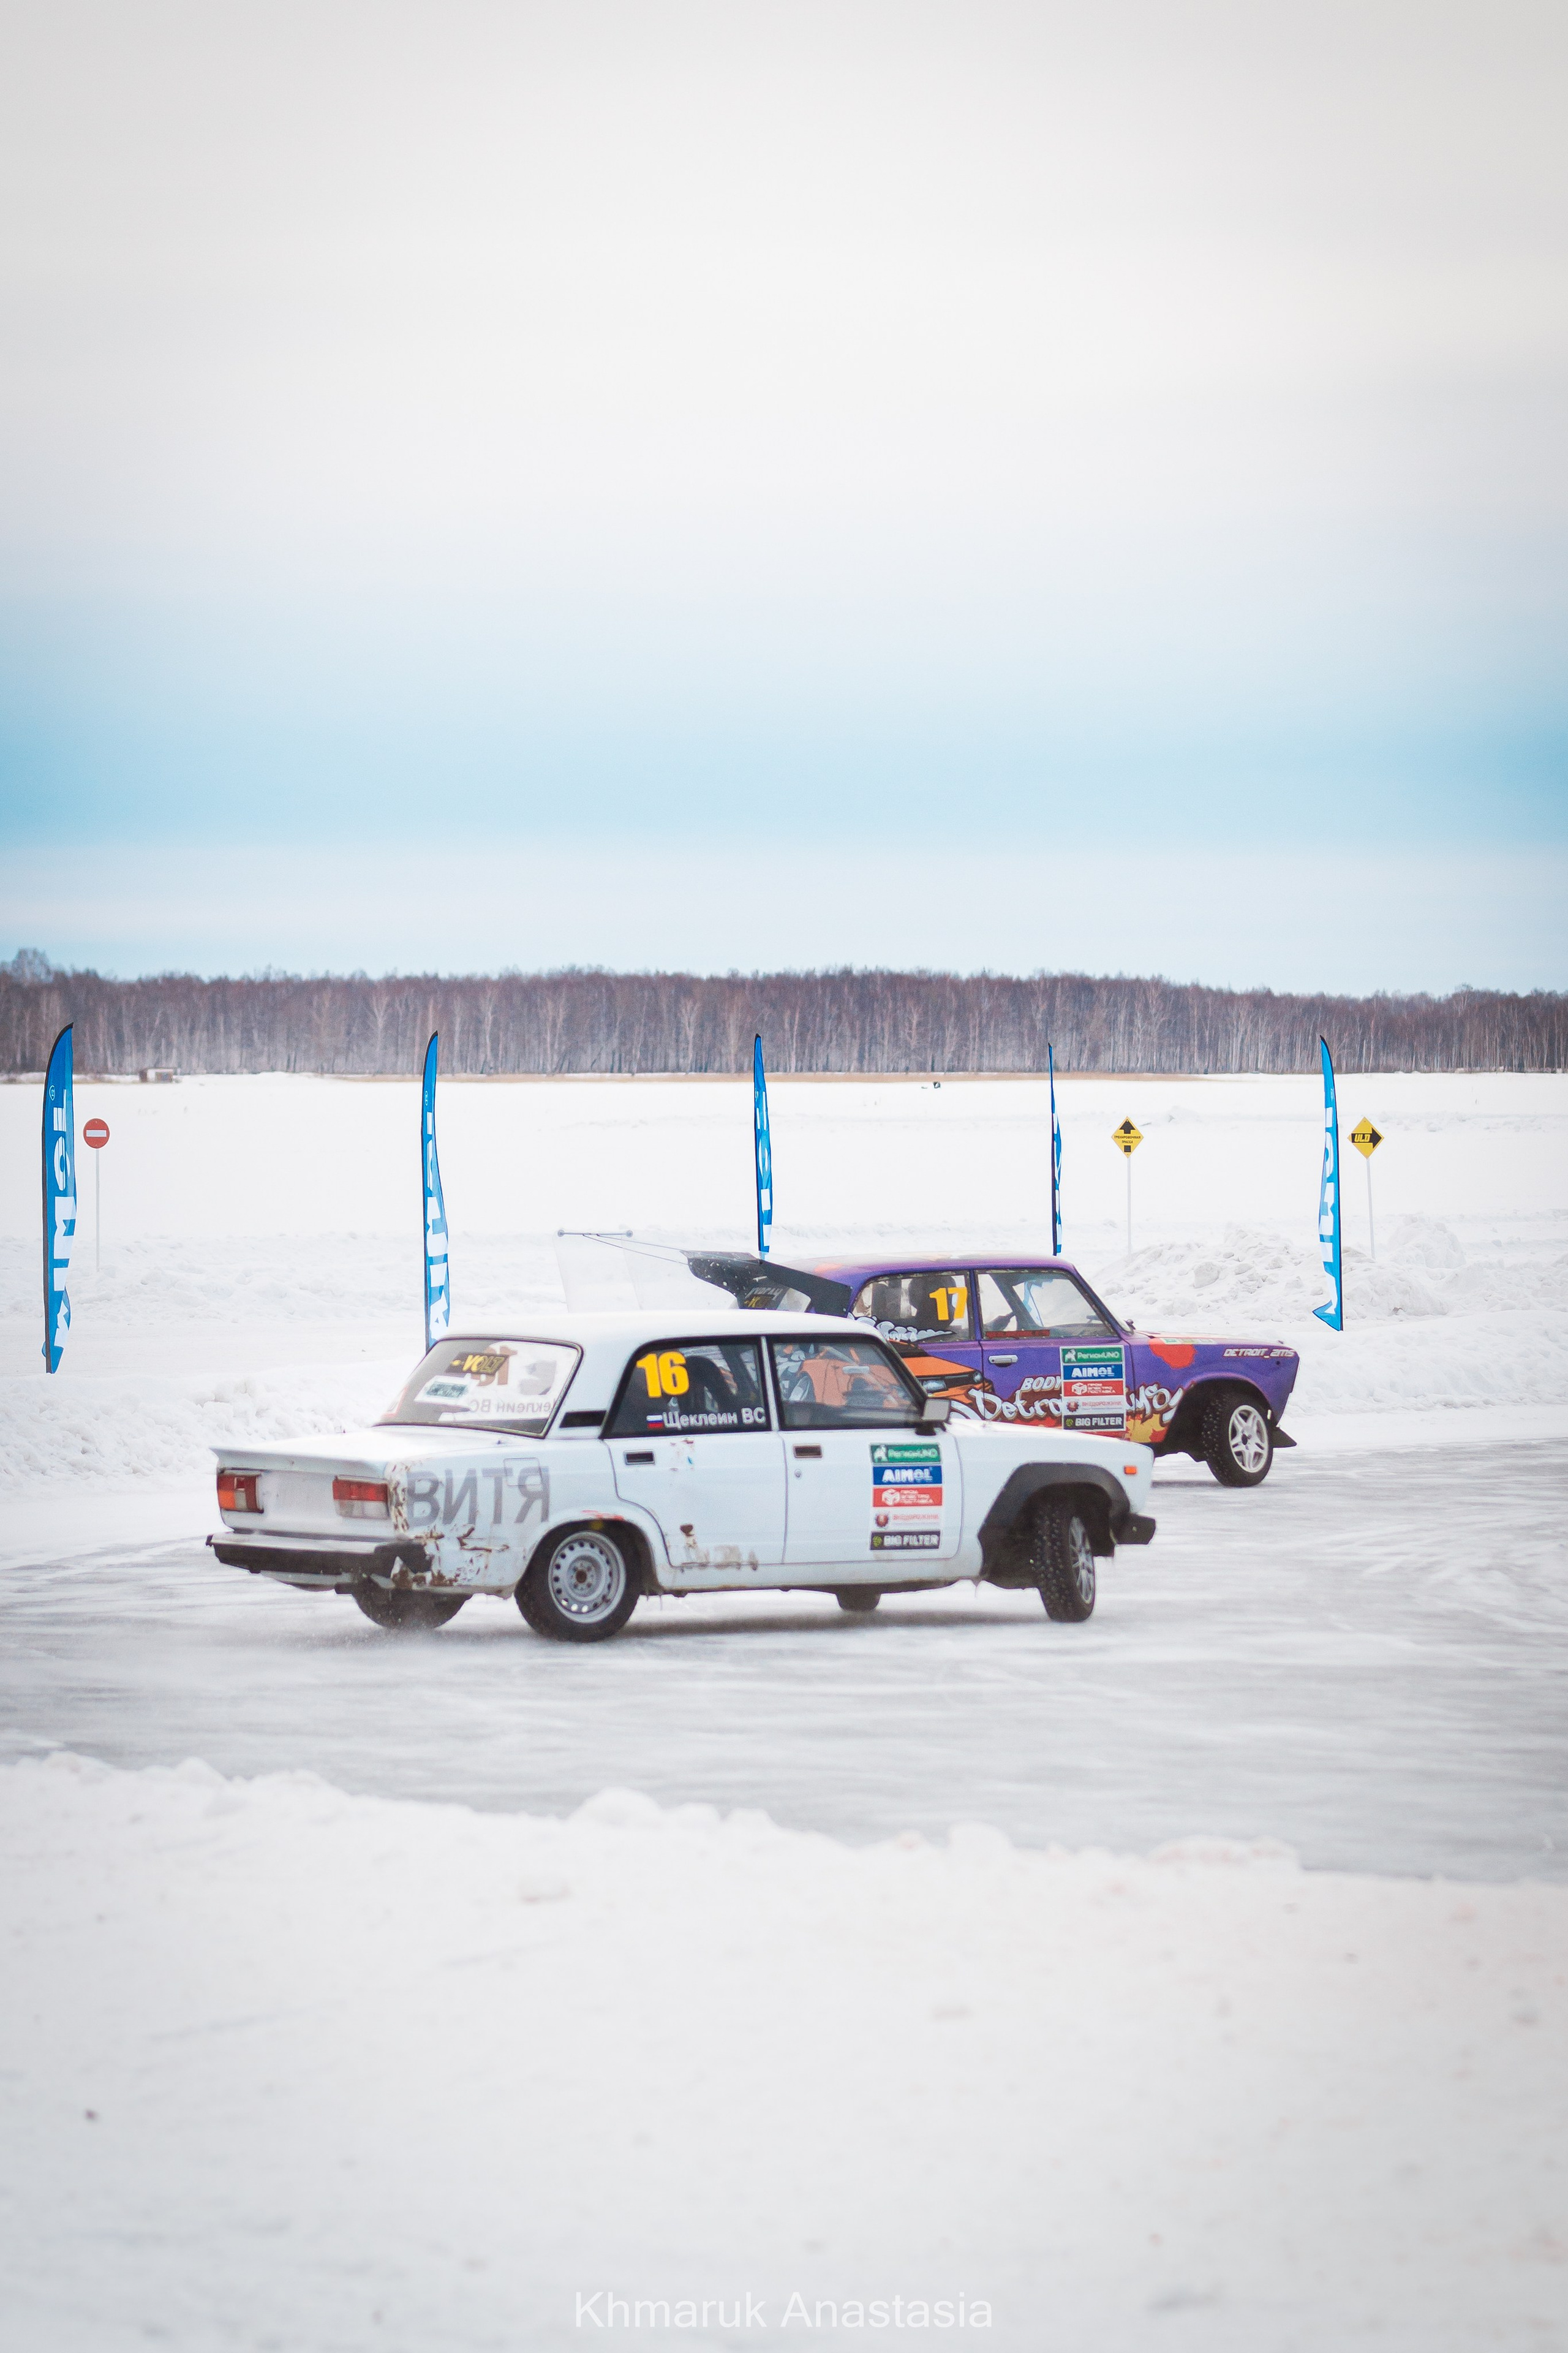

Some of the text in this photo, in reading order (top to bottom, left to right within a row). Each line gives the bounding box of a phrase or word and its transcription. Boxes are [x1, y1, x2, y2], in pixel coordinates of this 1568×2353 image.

[1354, 1133, 1371, 1143] ULD
[929, 1286, 968, 1321] 17
[462, 1354, 506, 1375] VOLT
[1071, 1367, 1115, 1377] AIMOL
[636, 1351, 690, 1399] 16
[741, 1407, 766, 1424] ВС
[1075, 1417, 1123, 1426] BIG FILTER
[882, 1468, 933, 1483] AIMOL
[407, 1465, 550, 1528] ВИТЯ
[883, 1535, 939, 1546] BIG FILTER
